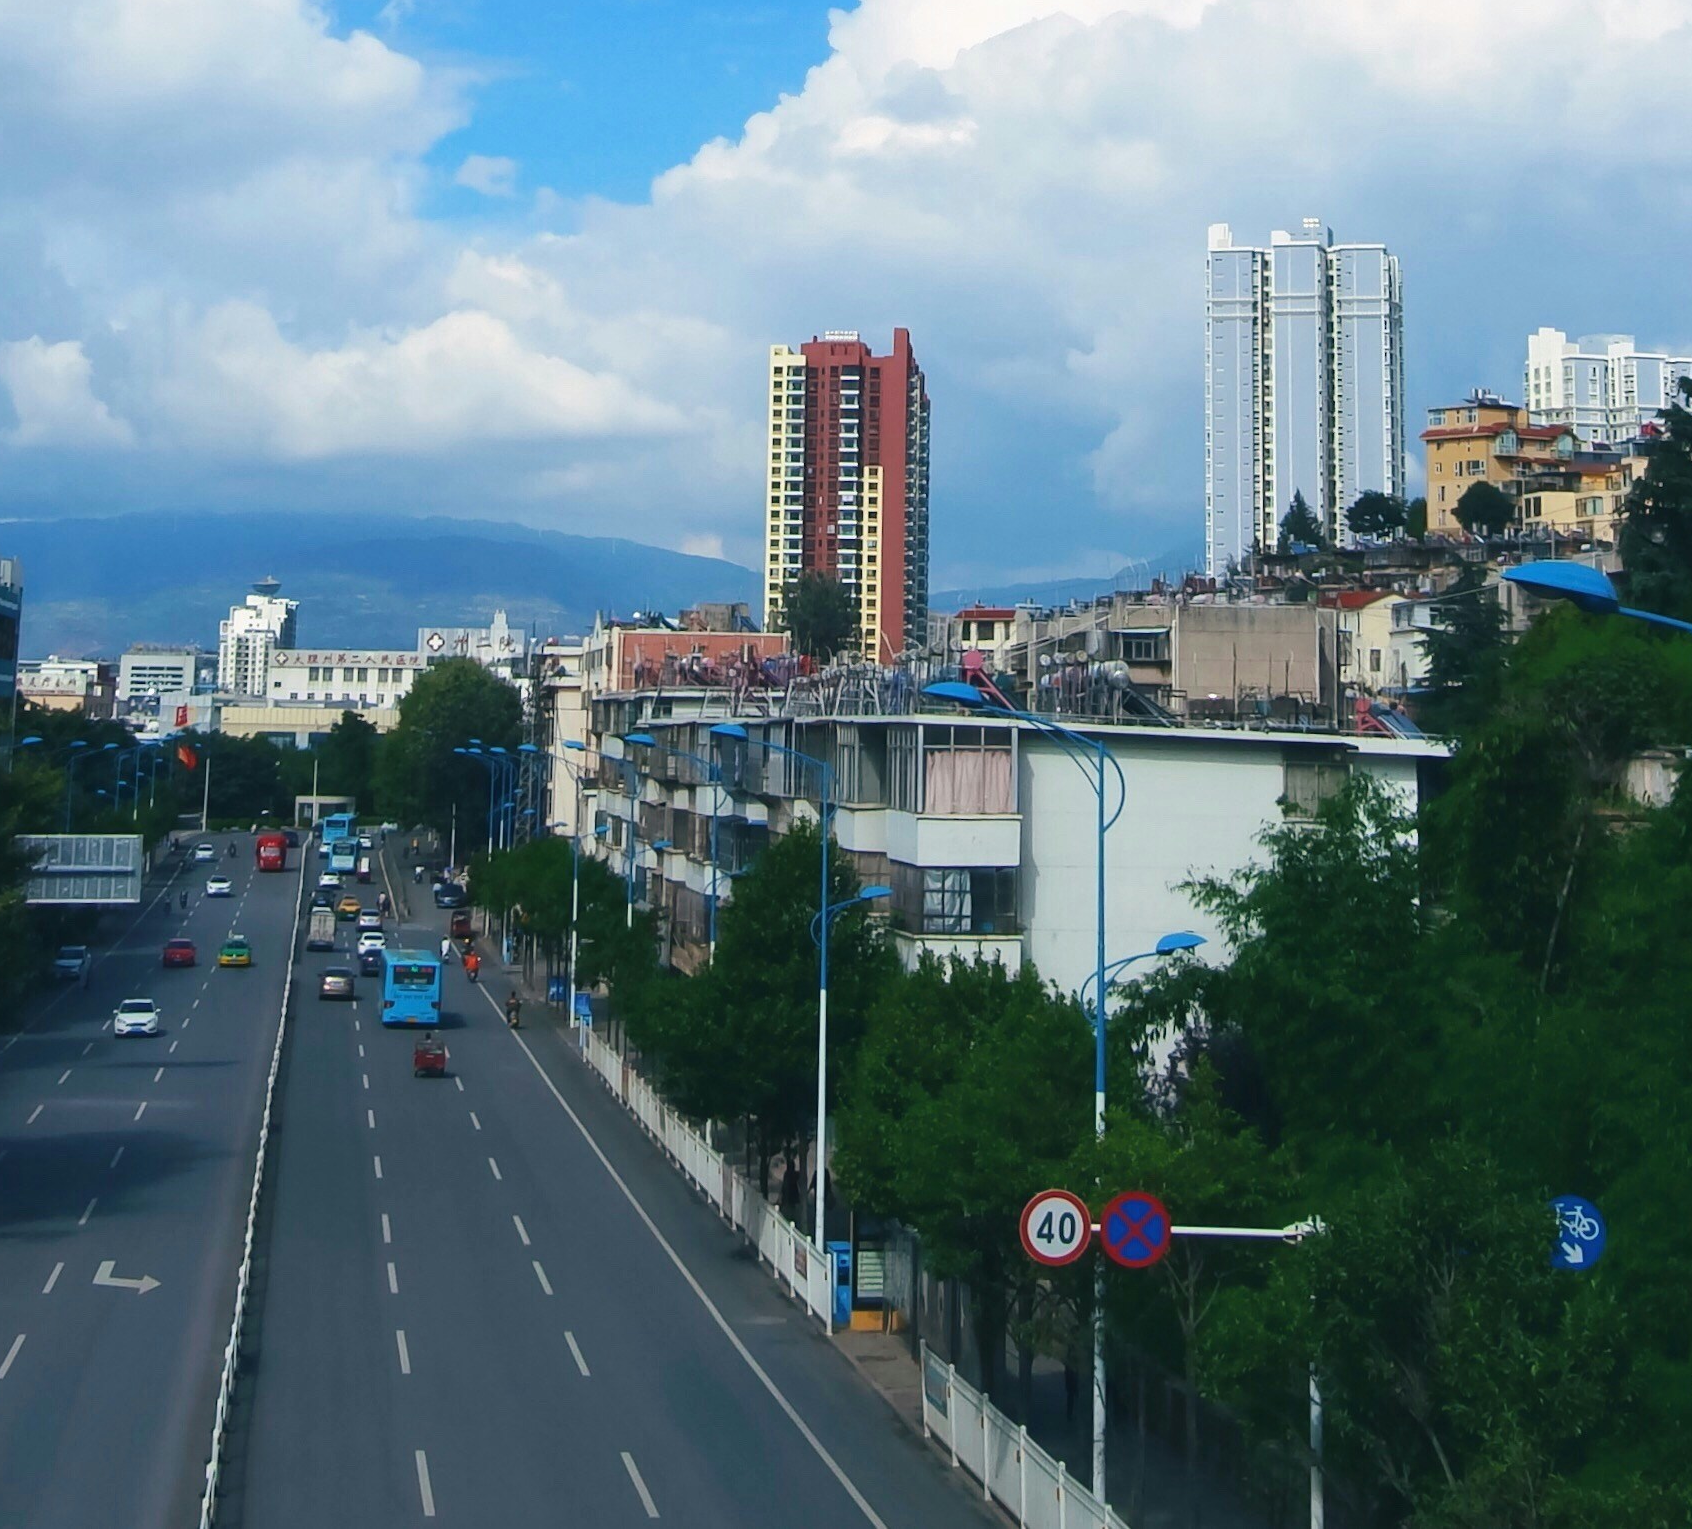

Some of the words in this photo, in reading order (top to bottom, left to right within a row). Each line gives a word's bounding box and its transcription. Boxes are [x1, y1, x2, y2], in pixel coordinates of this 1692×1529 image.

[452, 625, 517, 654] 州二院
[293, 653, 422, 666] 大理州第二人民医院
[1036, 1211, 1076, 1245] 40
